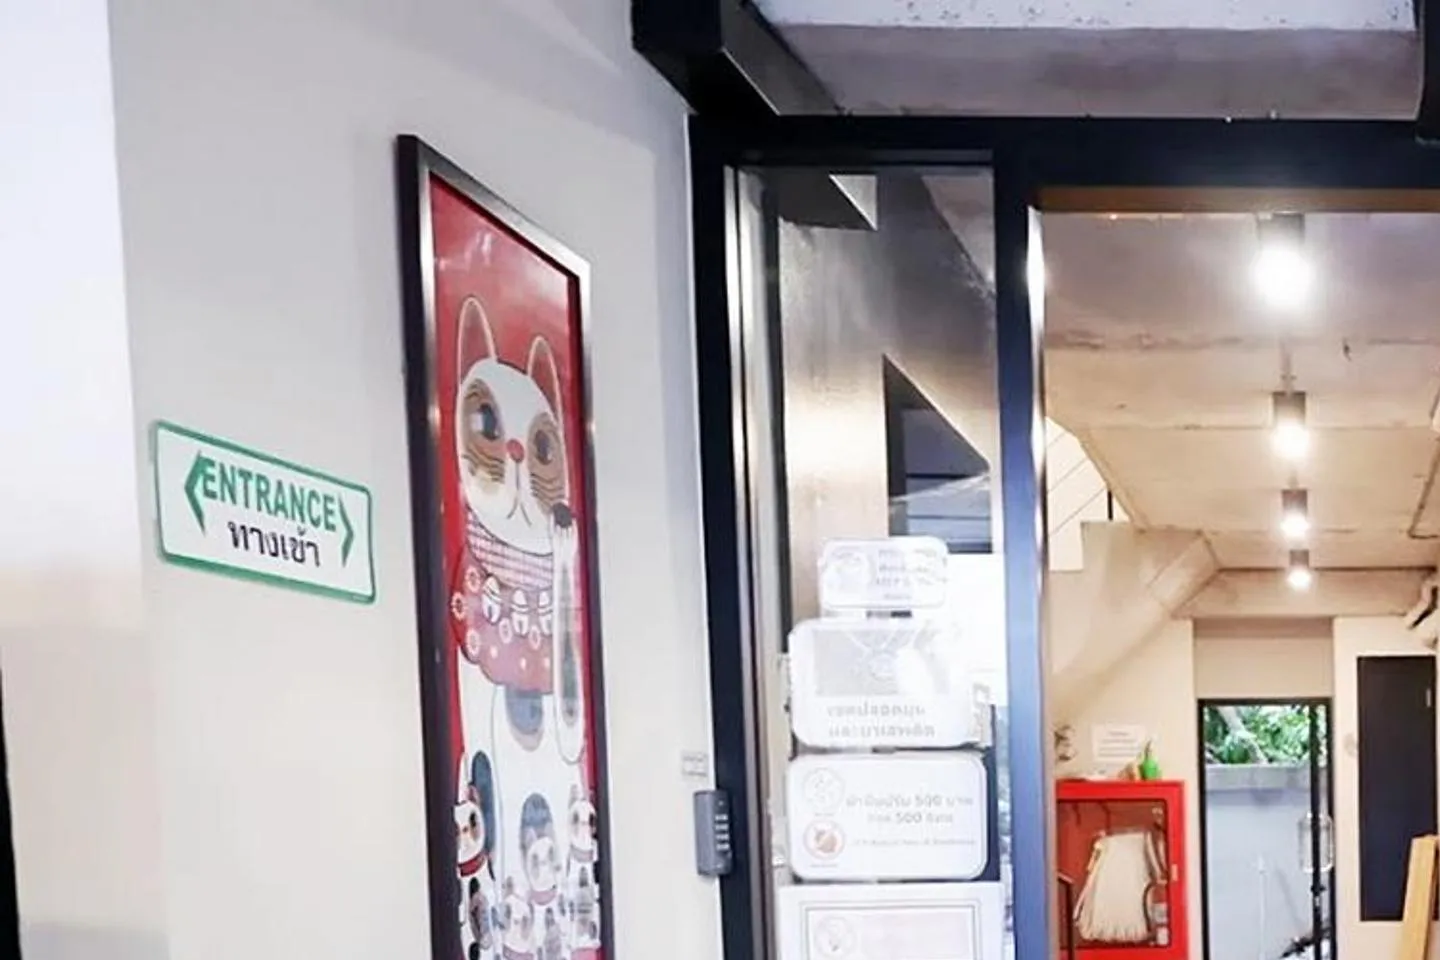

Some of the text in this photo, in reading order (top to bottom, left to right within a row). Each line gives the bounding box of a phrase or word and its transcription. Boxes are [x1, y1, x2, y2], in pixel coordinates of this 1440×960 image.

[201, 455, 337, 533] ENTRANCE
[227, 521, 320, 567] ทางเข้า
